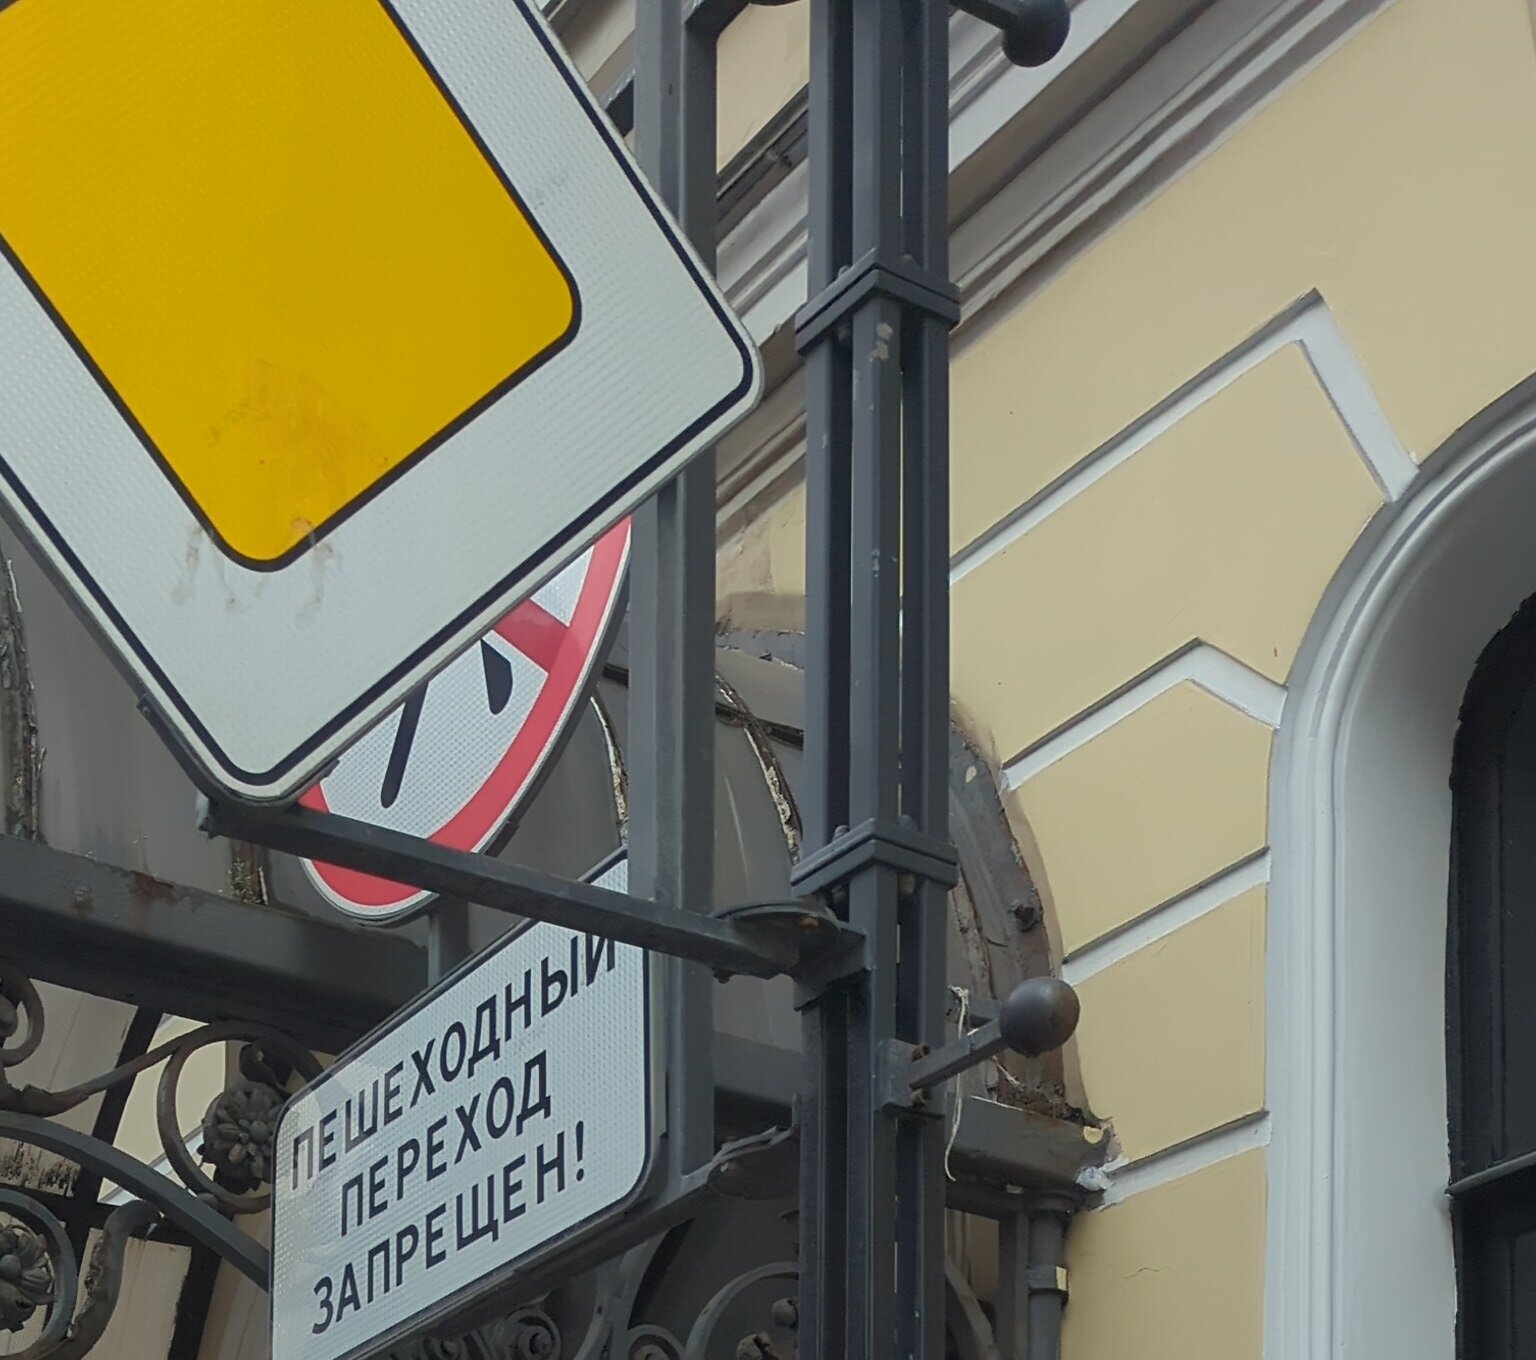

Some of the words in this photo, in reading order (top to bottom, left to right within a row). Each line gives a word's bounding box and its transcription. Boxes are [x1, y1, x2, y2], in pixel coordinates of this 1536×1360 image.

[292, 933, 616, 1191] ПЕШЕХОДНЫЙ
[340, 1050, 552, 1237] ПЕРЕХОД
[311, 1120, 586, 1335] ЗАПРЕЩЕН!
